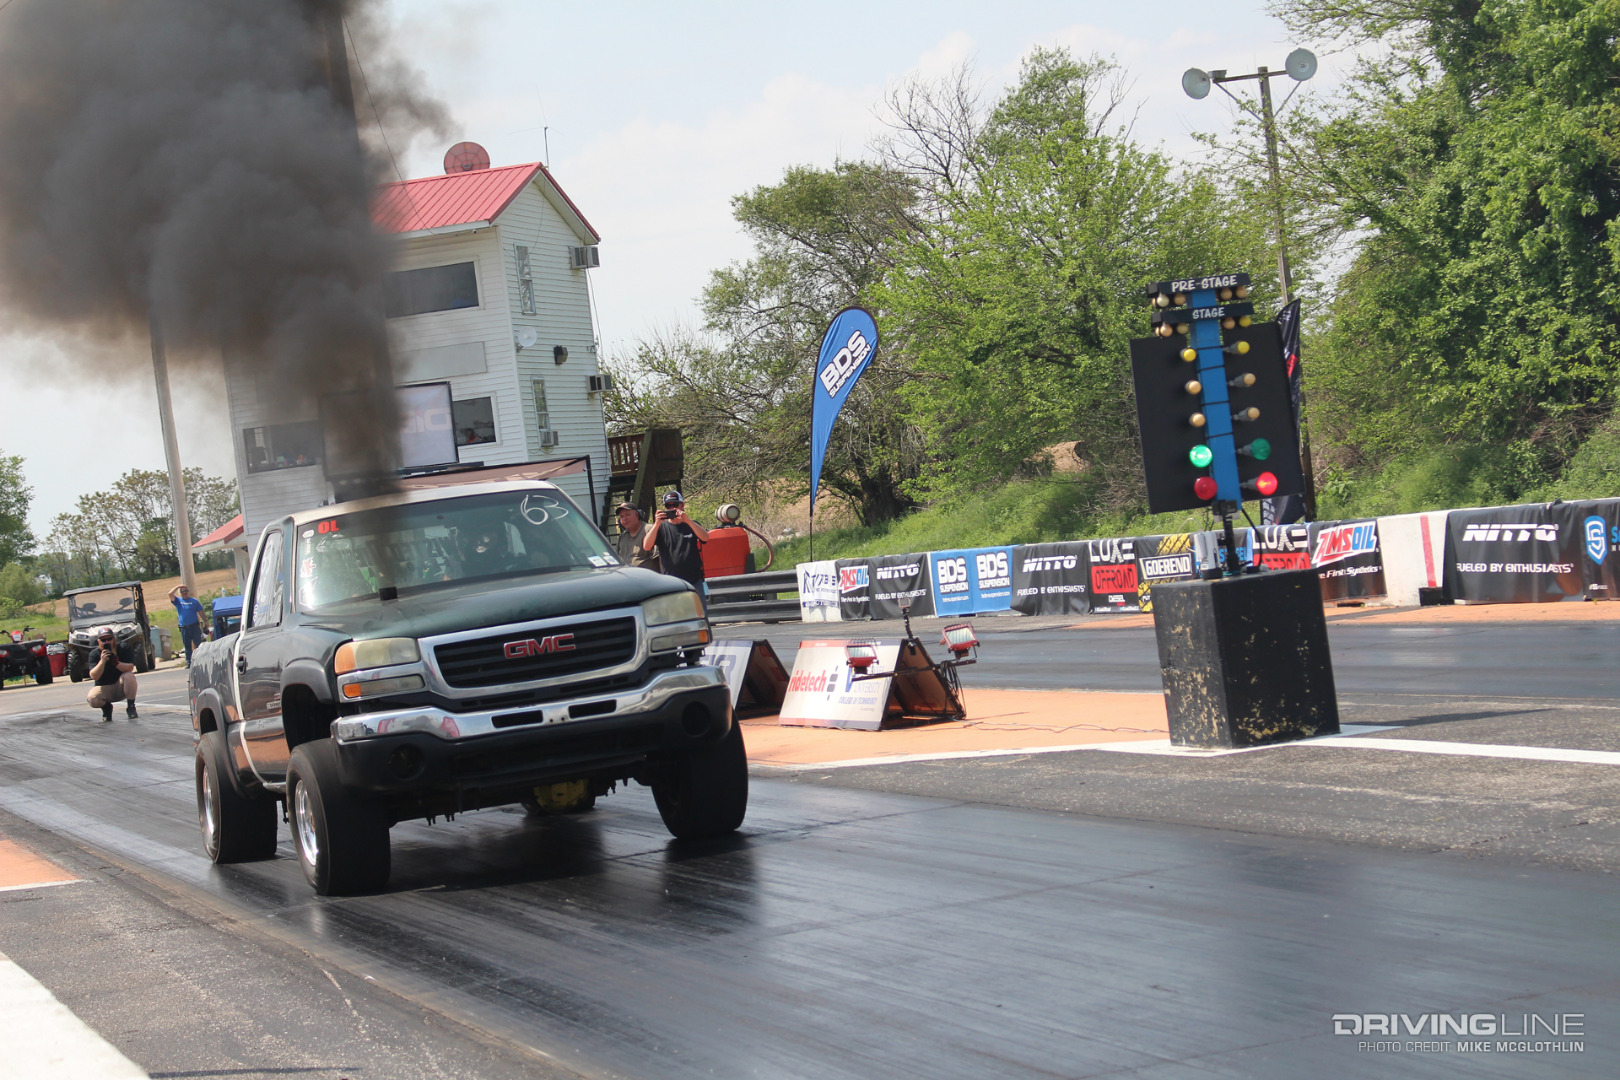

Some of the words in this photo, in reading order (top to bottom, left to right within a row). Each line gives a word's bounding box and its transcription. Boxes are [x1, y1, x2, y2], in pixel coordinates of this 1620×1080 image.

[1171, 275, 1238, 292] PRE-STAGE
[1192, 307, 1225, 320] STAGE
[819, 330, 866, 393] BDS
[829, 344, 872, 398] SUSPENSION
[520, 494, 569, 525] 63
[1462, 523, 1556, 541] NITTO
[1315, 524, 1375, 563] AMSOIL
[876, 563, 919, 580] NITTO
[937, 557, 967, 584] BDS
[976, 551, 1009, 579] BDS
[1022, 555, 1077, 572] NITTO
[1146, 557, 1191, 576] GOEREND
[1457, 562, 1487, 573] FUELED
[1490, 562, 1503, 573] BY
[1505, 562, 1571, 574] ENTHUSIASTS
[839, 568, 869, 591] AMSOIL
[939, 582, 969, 593] SUSPENSION
[978, 577, 1010, 589] SUSPENSION
[1094, 567, 1135, 590] OFFROAD
[504, 632, 576, 659] GMC
[788, 670, 827, 692] ridetech
